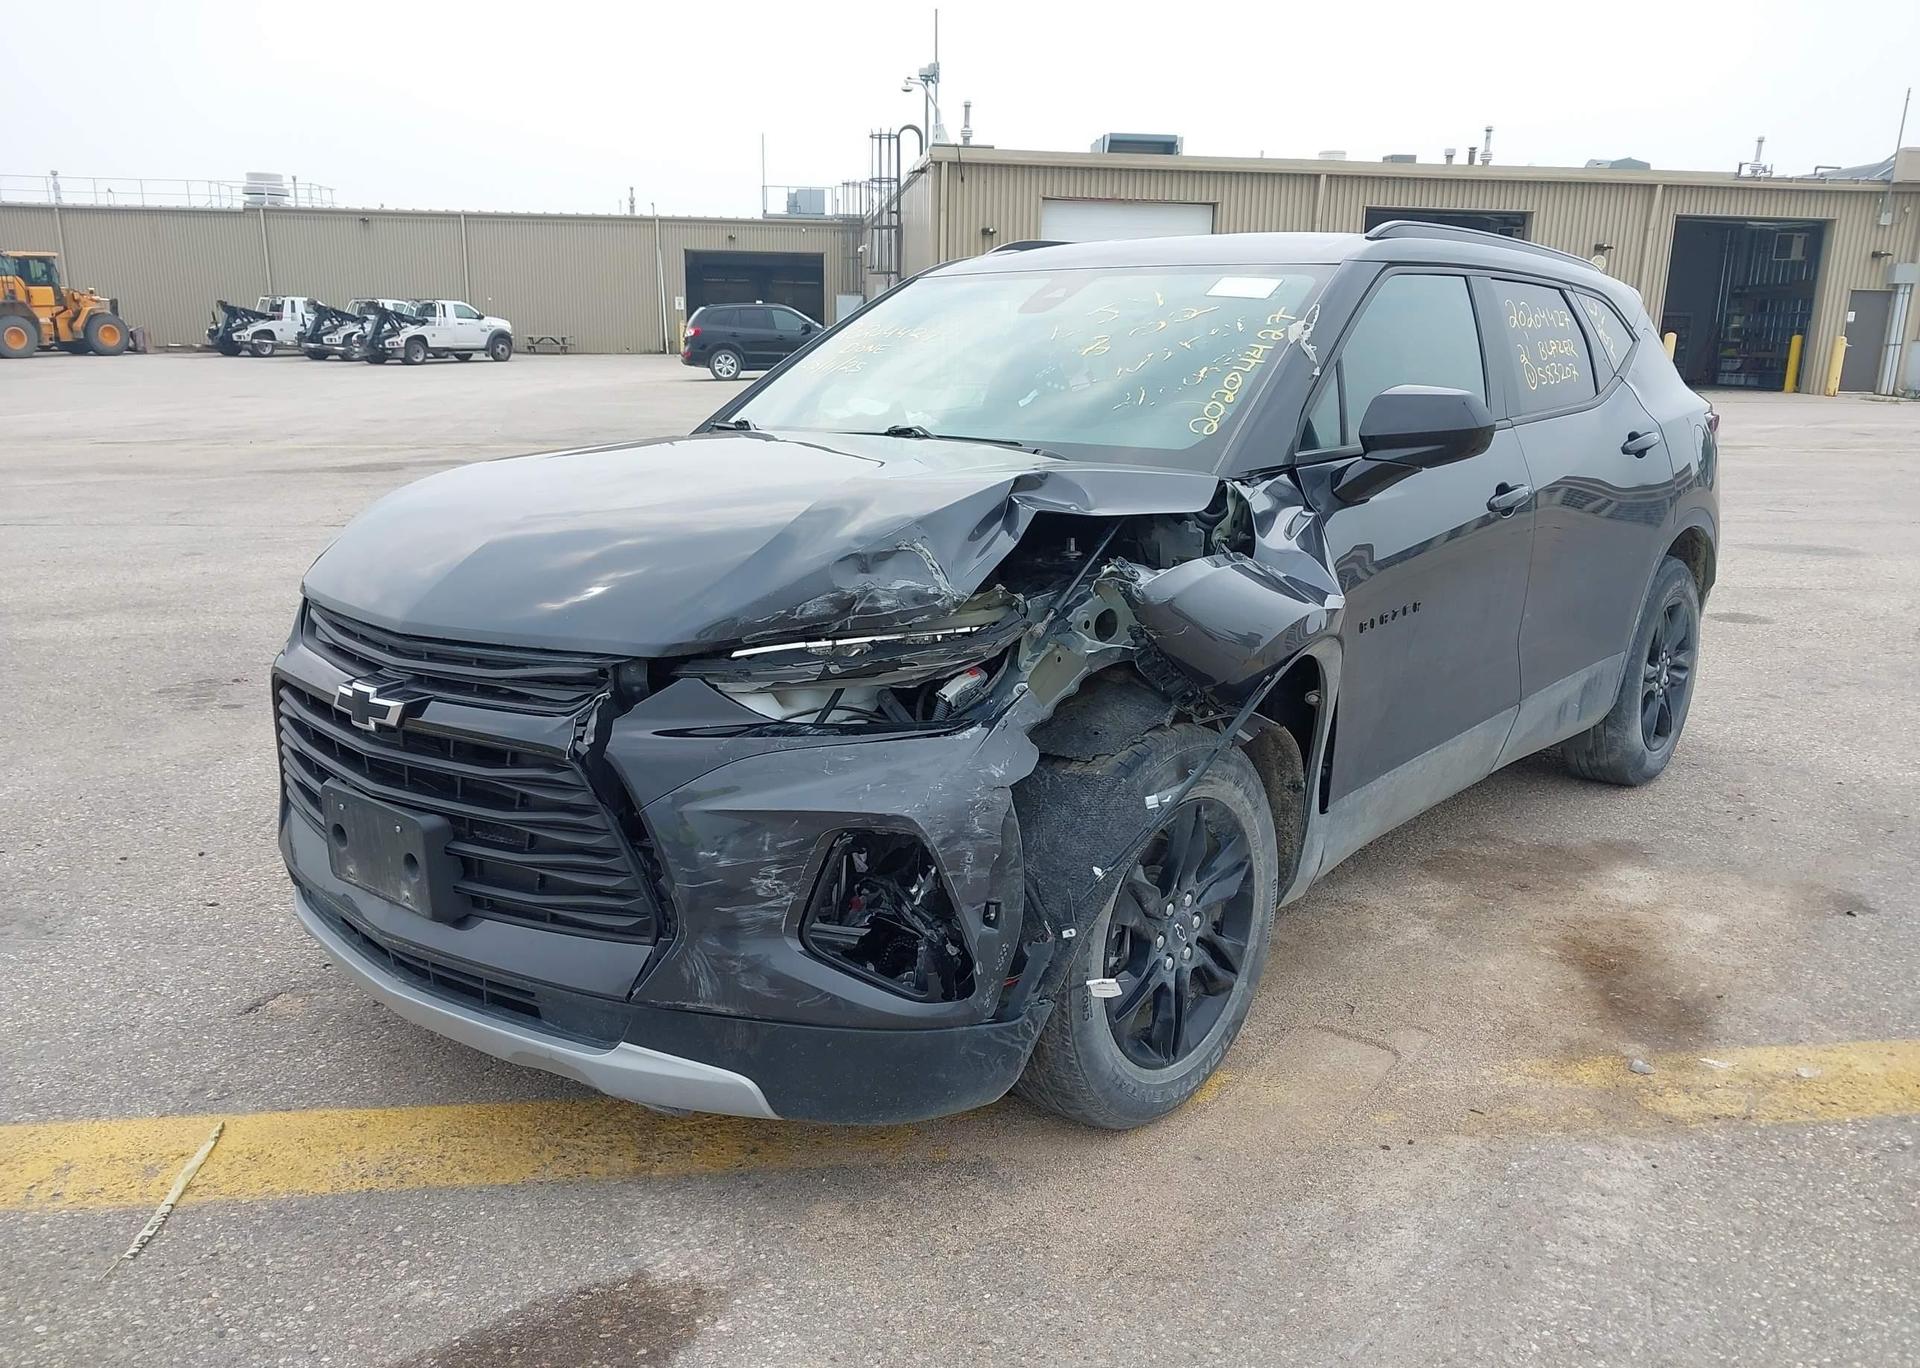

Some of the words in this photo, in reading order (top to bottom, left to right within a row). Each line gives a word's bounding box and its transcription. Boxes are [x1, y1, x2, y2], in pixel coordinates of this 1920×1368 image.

[1504, 299, 1571, 330] 20204427
[1537, 339, 1580, 361] BLAZER
[1189, 306, 1297, 436] 20204427
